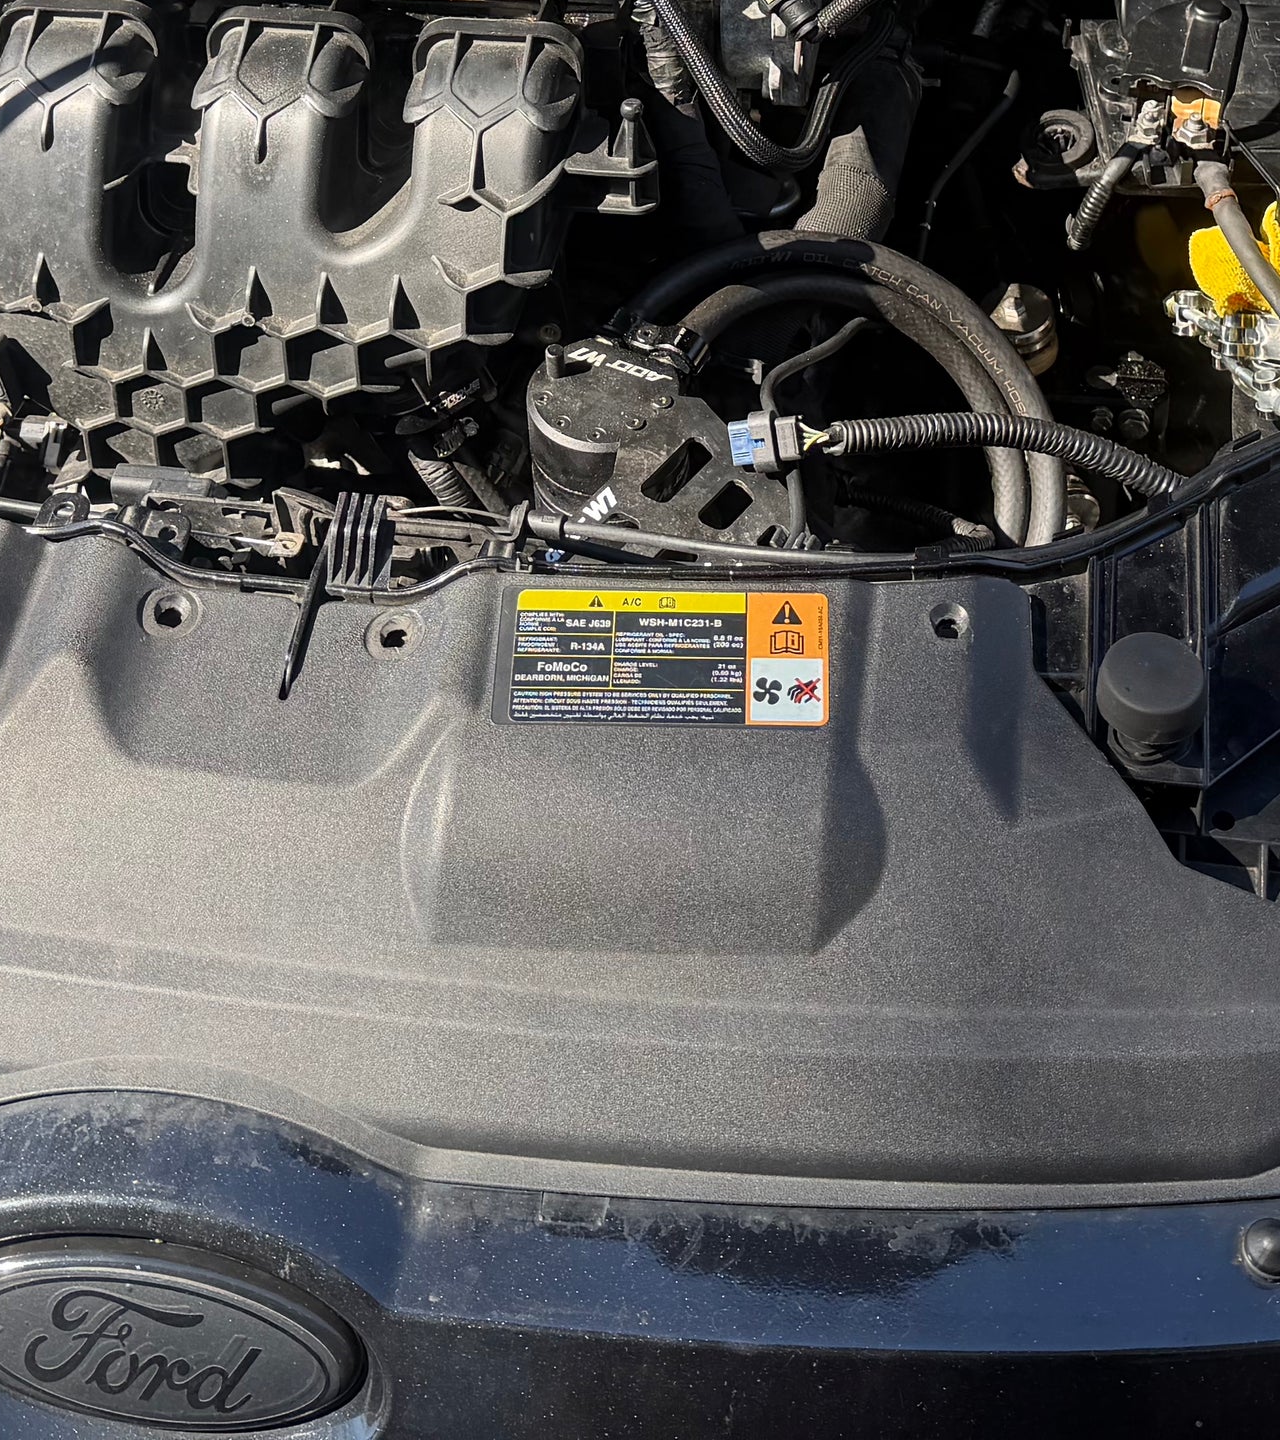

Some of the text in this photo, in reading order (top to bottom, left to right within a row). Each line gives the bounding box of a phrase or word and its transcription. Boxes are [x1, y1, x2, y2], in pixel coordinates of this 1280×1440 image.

[803, 252, 833, 265] OIL
[842, 258, 902, 287] CATCH
[906, 284, 943, 311] CAN
[948, 309, 1005, 375] VACUUM
[622, 597, 642, 607] A/C
[565, 619, 611, 628] SAE J639
[639, 618, 722, 628] WSH-M1C231-B
[570, 642, 605, 651] R-134A
[537, 661, 588, 672] FoMoCo
[514, 674, 609, 682] DEARBORN, MICHIGAN
[24, 1287, 263, 1414] Ford
